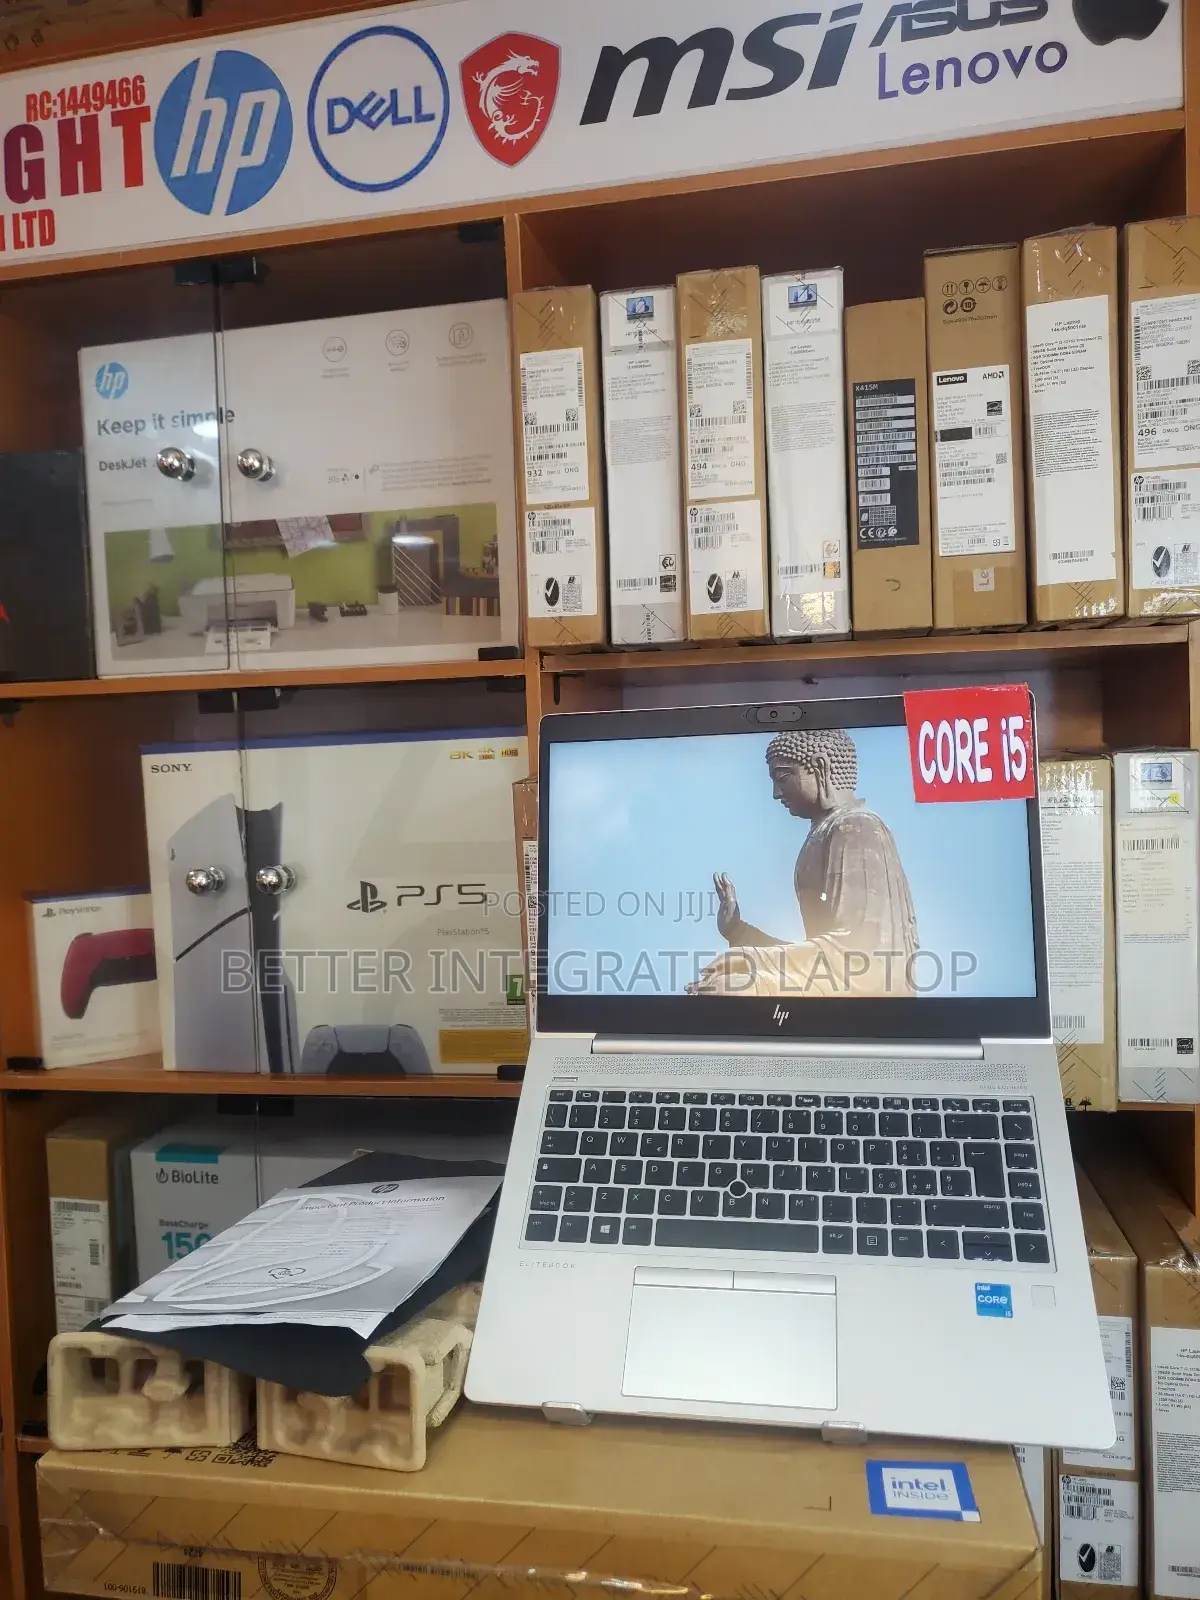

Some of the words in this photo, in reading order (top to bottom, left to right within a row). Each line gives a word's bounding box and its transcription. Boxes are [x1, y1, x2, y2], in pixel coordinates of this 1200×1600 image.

[868, 0, 1050, 48] ASUS
[579, 3, 865, 126] msi
[877, 40, 1069, 101] Lenovo
[26, 74, 147, 123] RC:1449466
[327, 85, 436, 137] DELL
[164, 50, 287, 216] hp
[3, 105, 152, 204] GHT
[12, 208, 56, 250] LTD
[98, 361, 127, 400] hp
[938, 373, 965, 384] Lenovo
[982, 371, 999, 381] AMD
[855, 383, 879, 392] X415M
[96, 418, 146, 436] Keep
[152, 412, 166, 431] it
[1138, 427, 1157, 437] 496
[98, 457, 148, 472] DeskJet
[527, 469, 543, 478] 932
[690, 462, 708, 471] 494
[730, 460, 746, 468] ONG
[449, 751, 474, 760] 8K
[918, 717, 993, 784] CORE
[1001, 715, 1027, 783] i5
[150, 763, 192, 773] SONY
[396, 883, 488, 907] PS5
[512, 977, 523, 997] 7
[171, 1169, 219, 1185] BioLite
[299, 1202, 348, 1211] Important
[348, 1198, 386, 1208] Product
[387, 1196, 446, 1205] Information
[890, 1476, 947, 1492] intel
